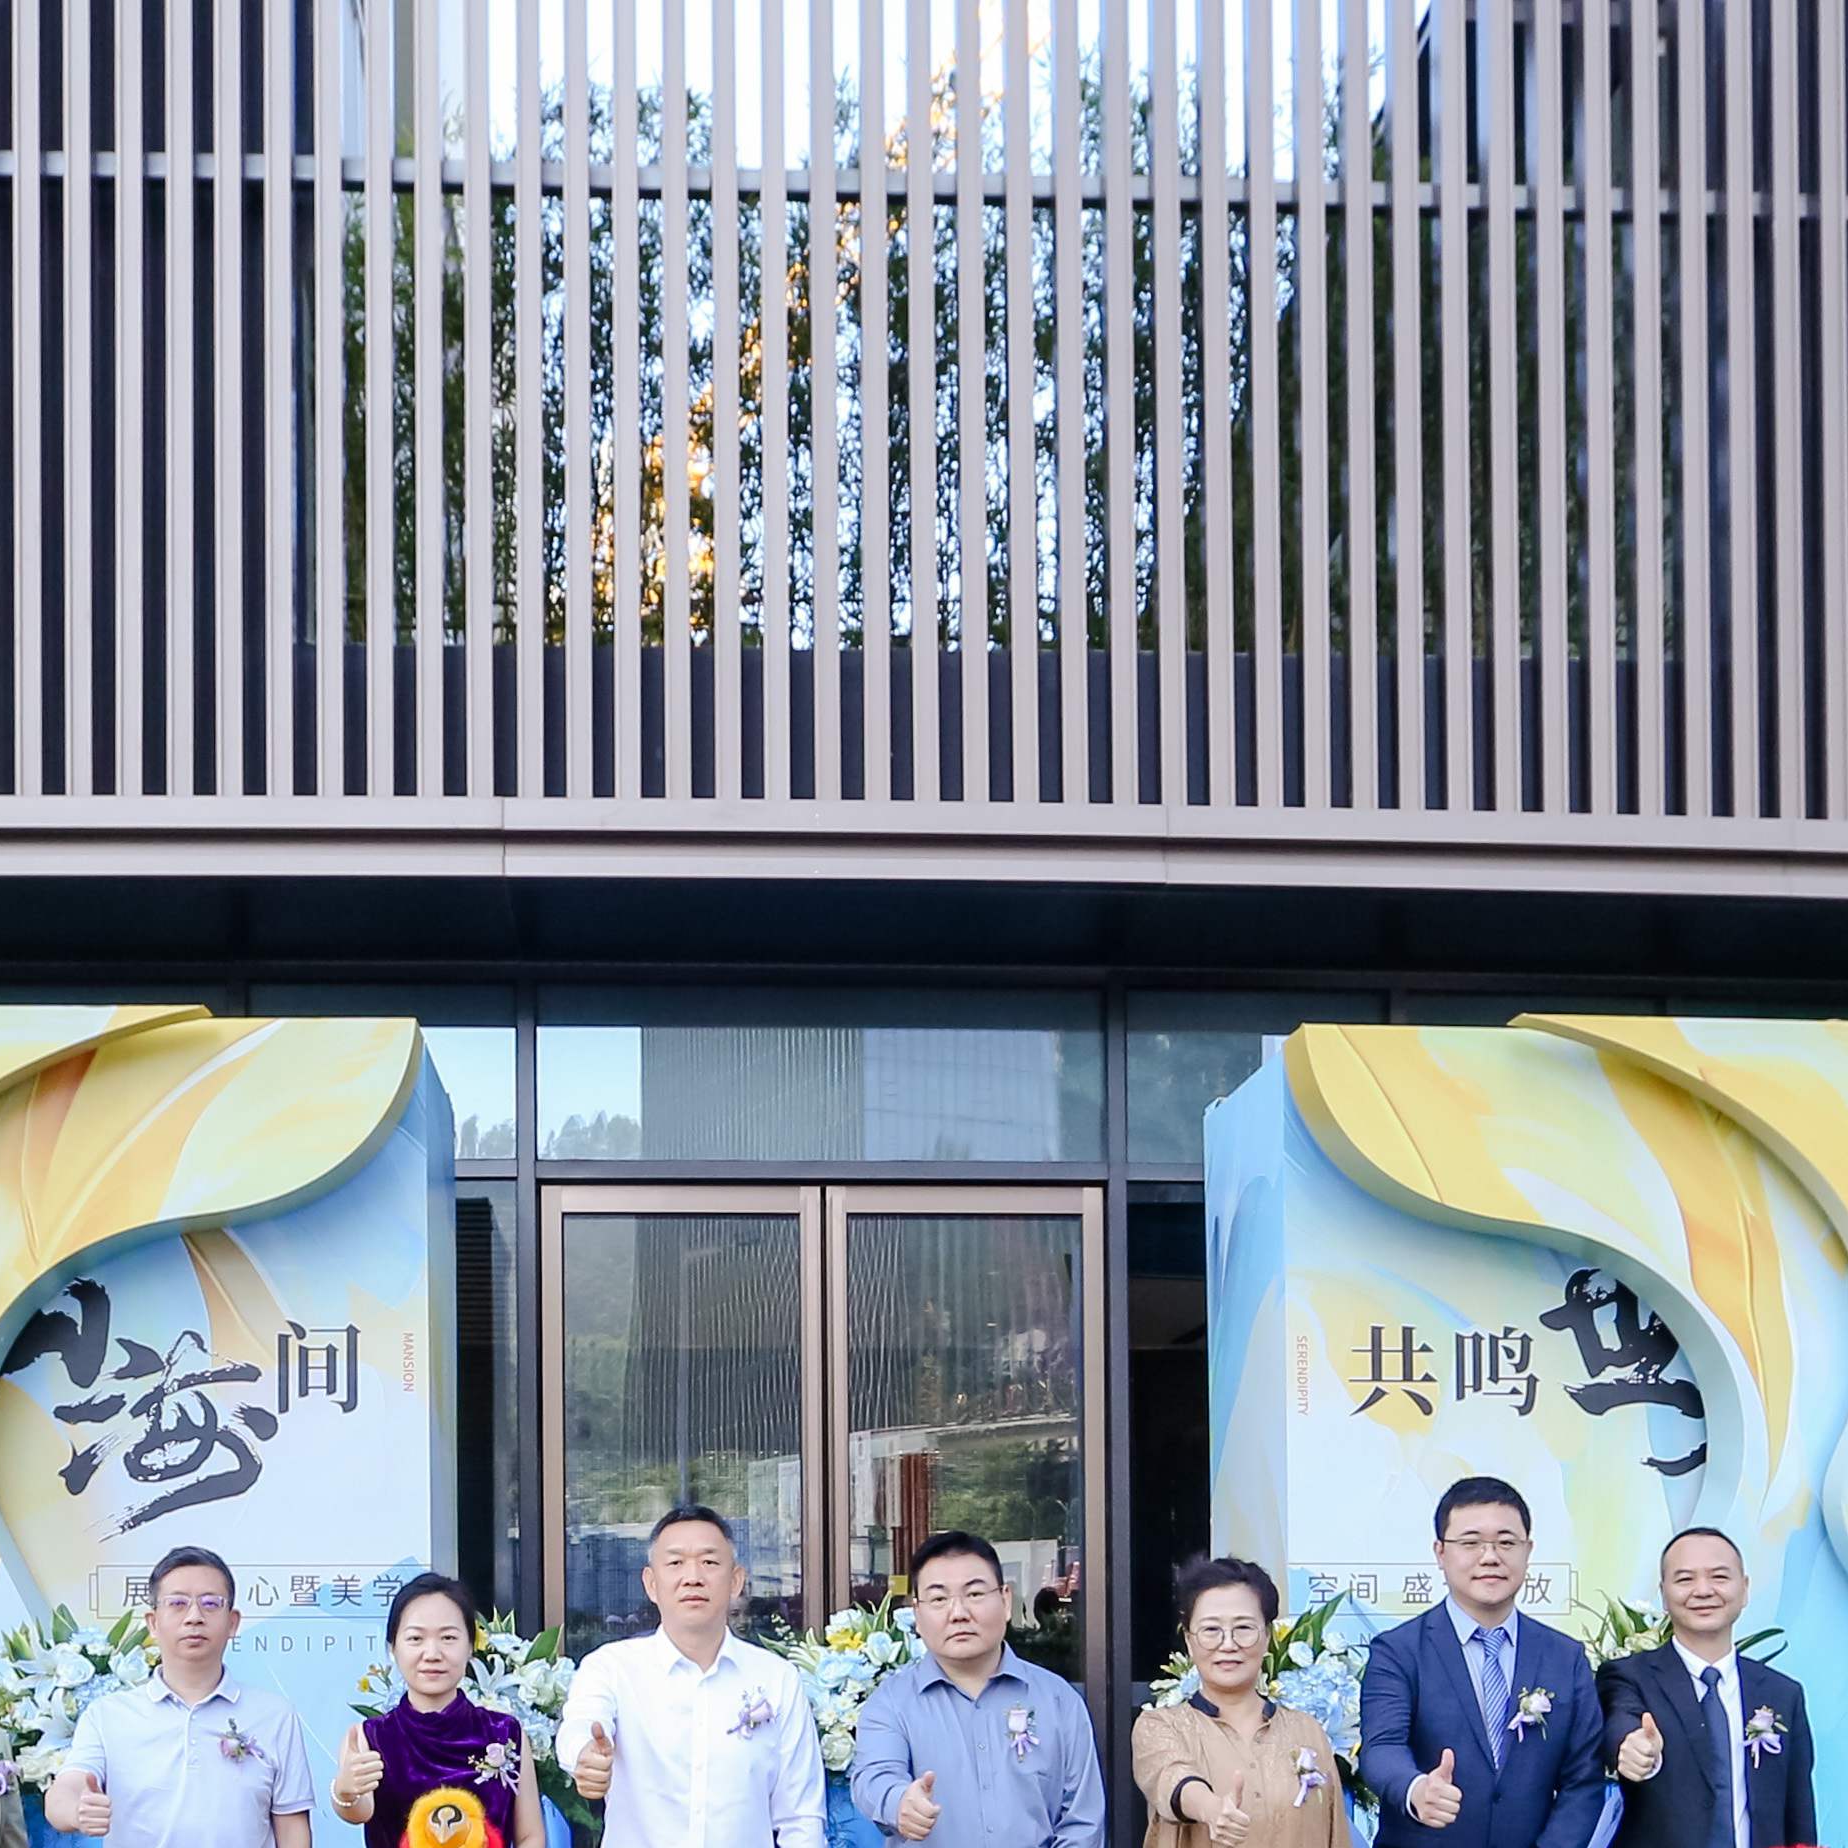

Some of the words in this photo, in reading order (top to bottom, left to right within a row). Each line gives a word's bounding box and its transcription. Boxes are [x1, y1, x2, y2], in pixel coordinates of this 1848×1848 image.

[402, 1332, 415, 1392] MANSION
[1296, 1335, 1310, 1416] SERENDIPITY
[1308, 1572, 1378, 1605] 空间
